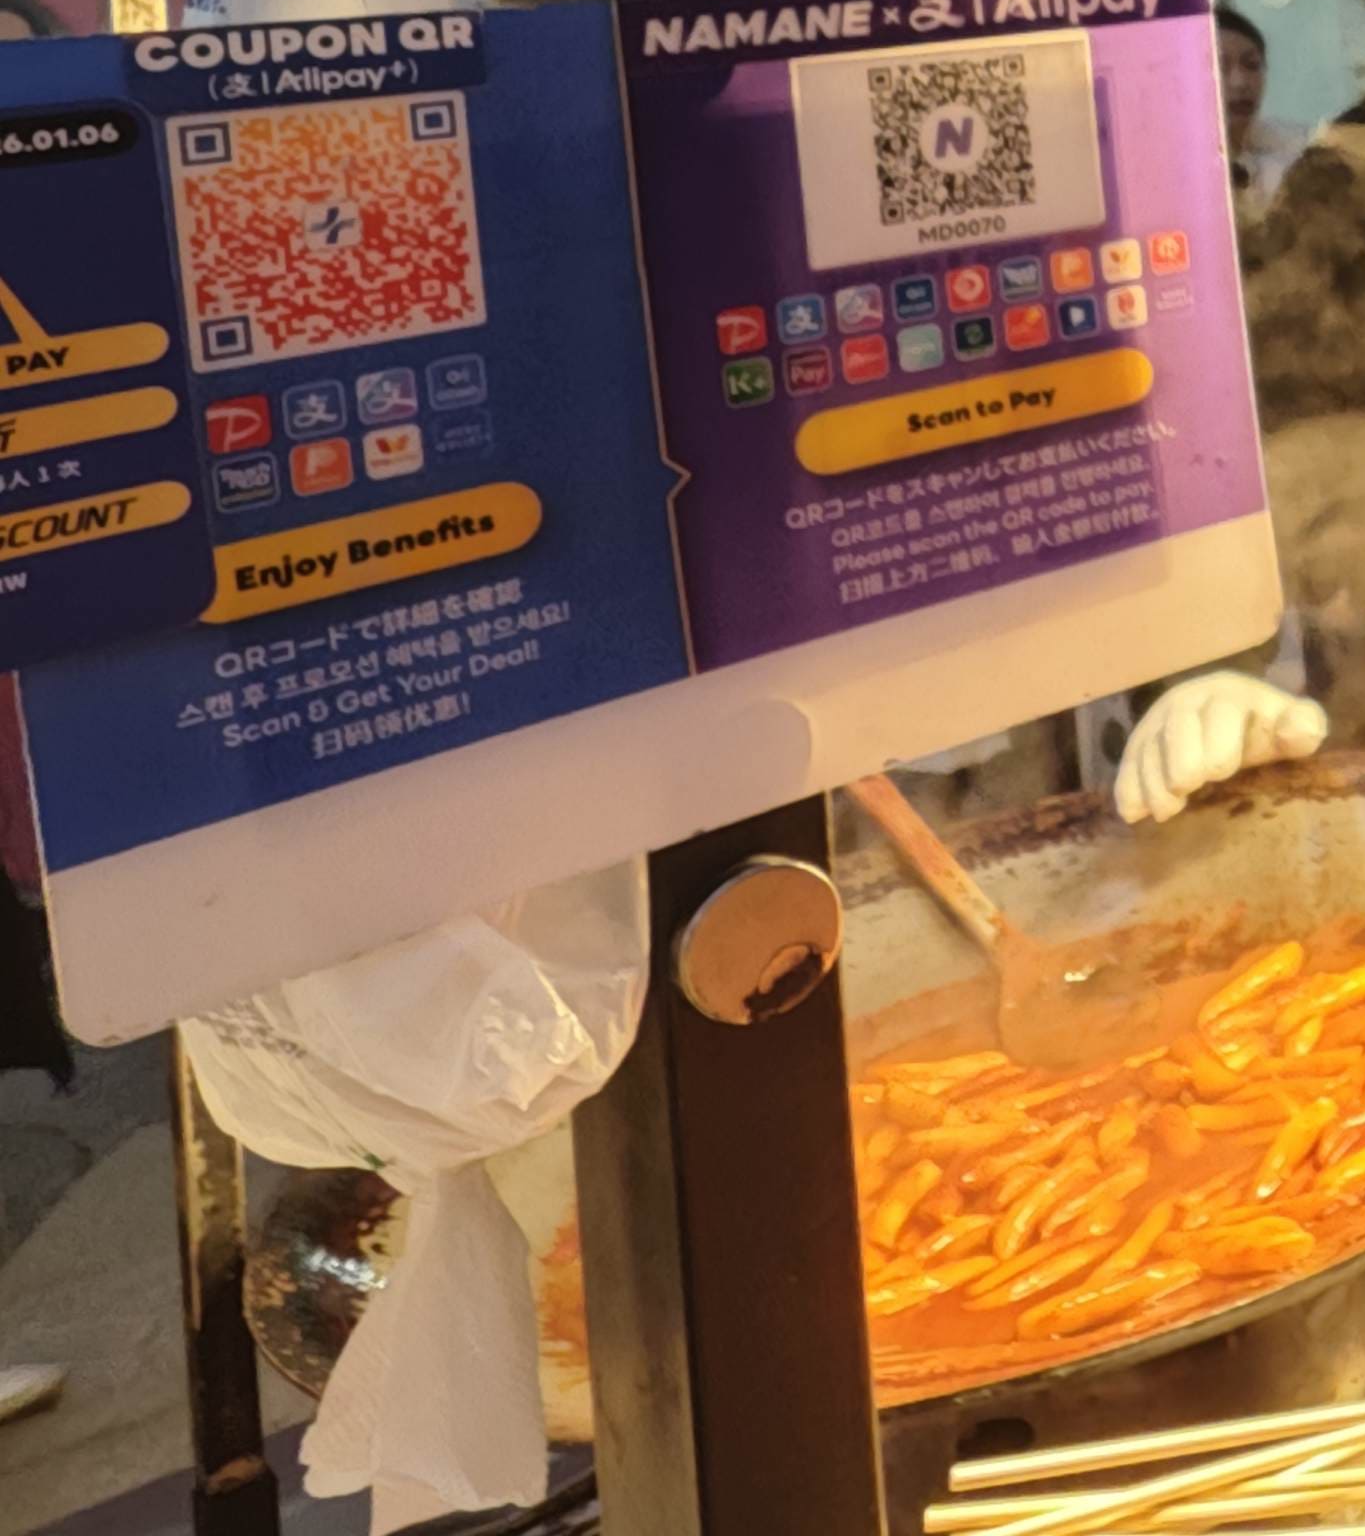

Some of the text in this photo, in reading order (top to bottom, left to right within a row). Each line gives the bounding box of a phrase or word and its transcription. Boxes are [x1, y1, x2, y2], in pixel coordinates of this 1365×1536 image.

[134, 15, 475, 72] COUPON QR
[642, 0, 873, 57] NAMANE
[0, 120, 121, 157] 6.01.06
[934, 117, 975, 159] N
[918, 215, 1007, 246] MD0070
[6, 346, 70, 376] PAY
[907, 384, 1056, 434] Scan to Pay
[908, 529, 960, 554] scan
[963, 518, 998, 542] the
[1002, 506, 1034, 531] QR
[1038, 494, 1086, 522] code
[235, 511, 496, 593] Enjoy Benefits
[222, 714, 302, 749] Scan
[337, 684, 392, 715] Get
[396, 665, 464, 698] Your
[469, 639, 541, 678] Deal!
[275, 650, 381, 701] 프로모션
